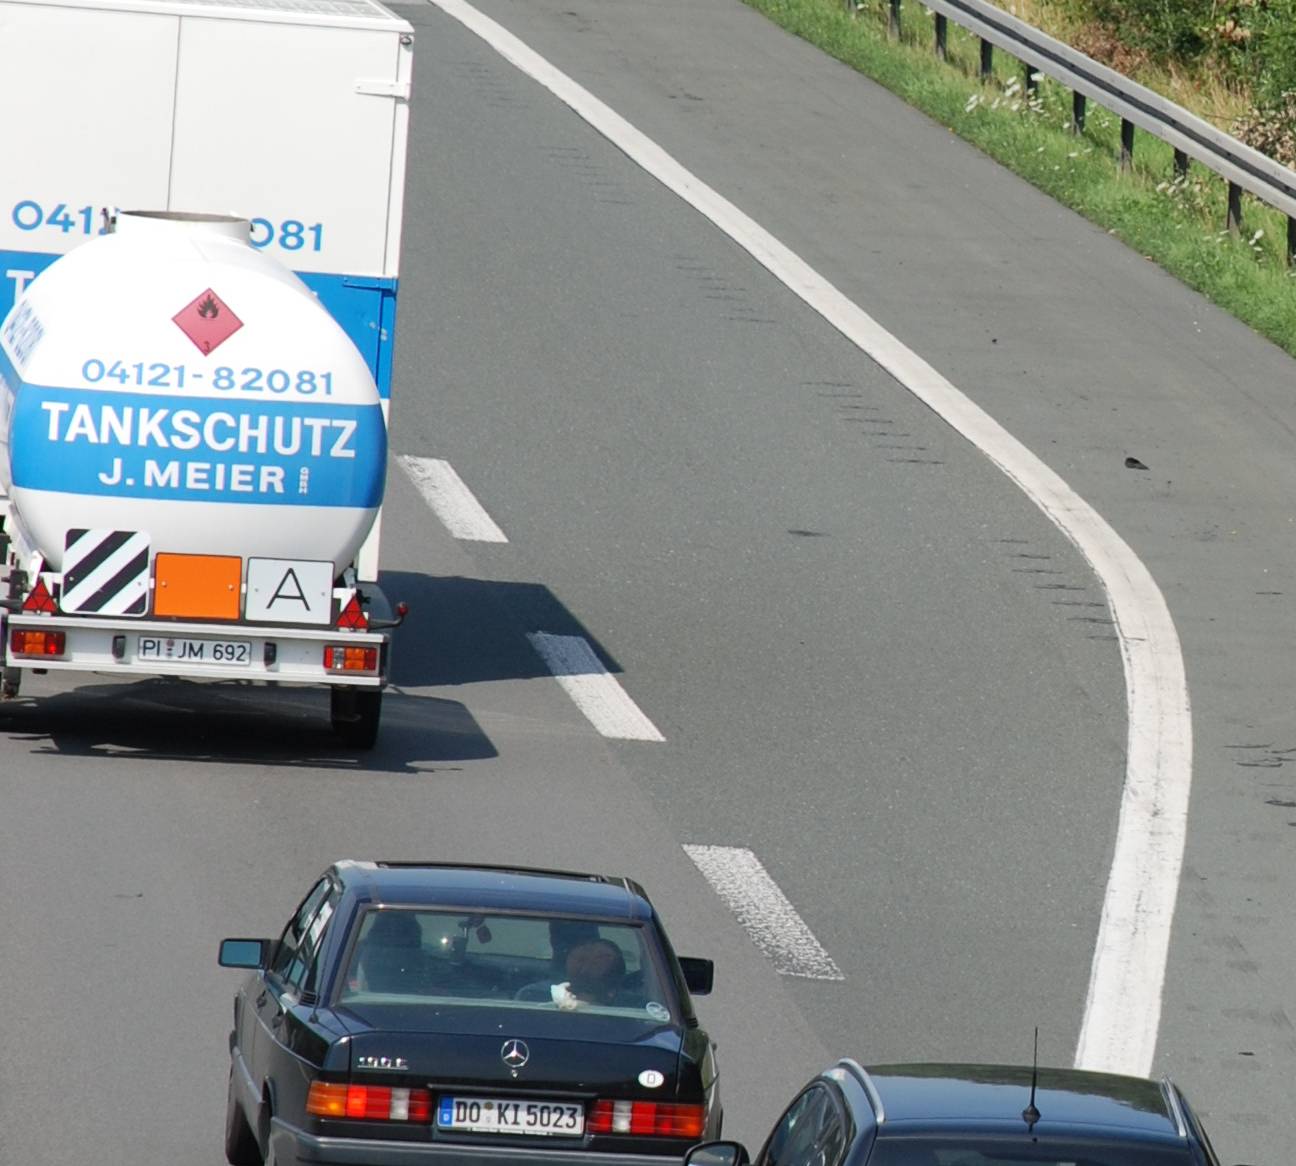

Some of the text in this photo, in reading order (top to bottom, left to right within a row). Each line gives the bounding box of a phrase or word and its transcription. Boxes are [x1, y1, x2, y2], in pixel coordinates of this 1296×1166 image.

[41, 401, 357, 458] TANKSCHUTZ
[98, 457, 135, 487] J.
[143, 459, 285, 494] MEIER
[266, 567, 311, 612] A
[142, 639, 247, 662] PI JM 692
[455, 1101, 481, 1123] DO
[497, 1103, 521, 1126] KI
[526, 1105, 578, 1129] 5023
